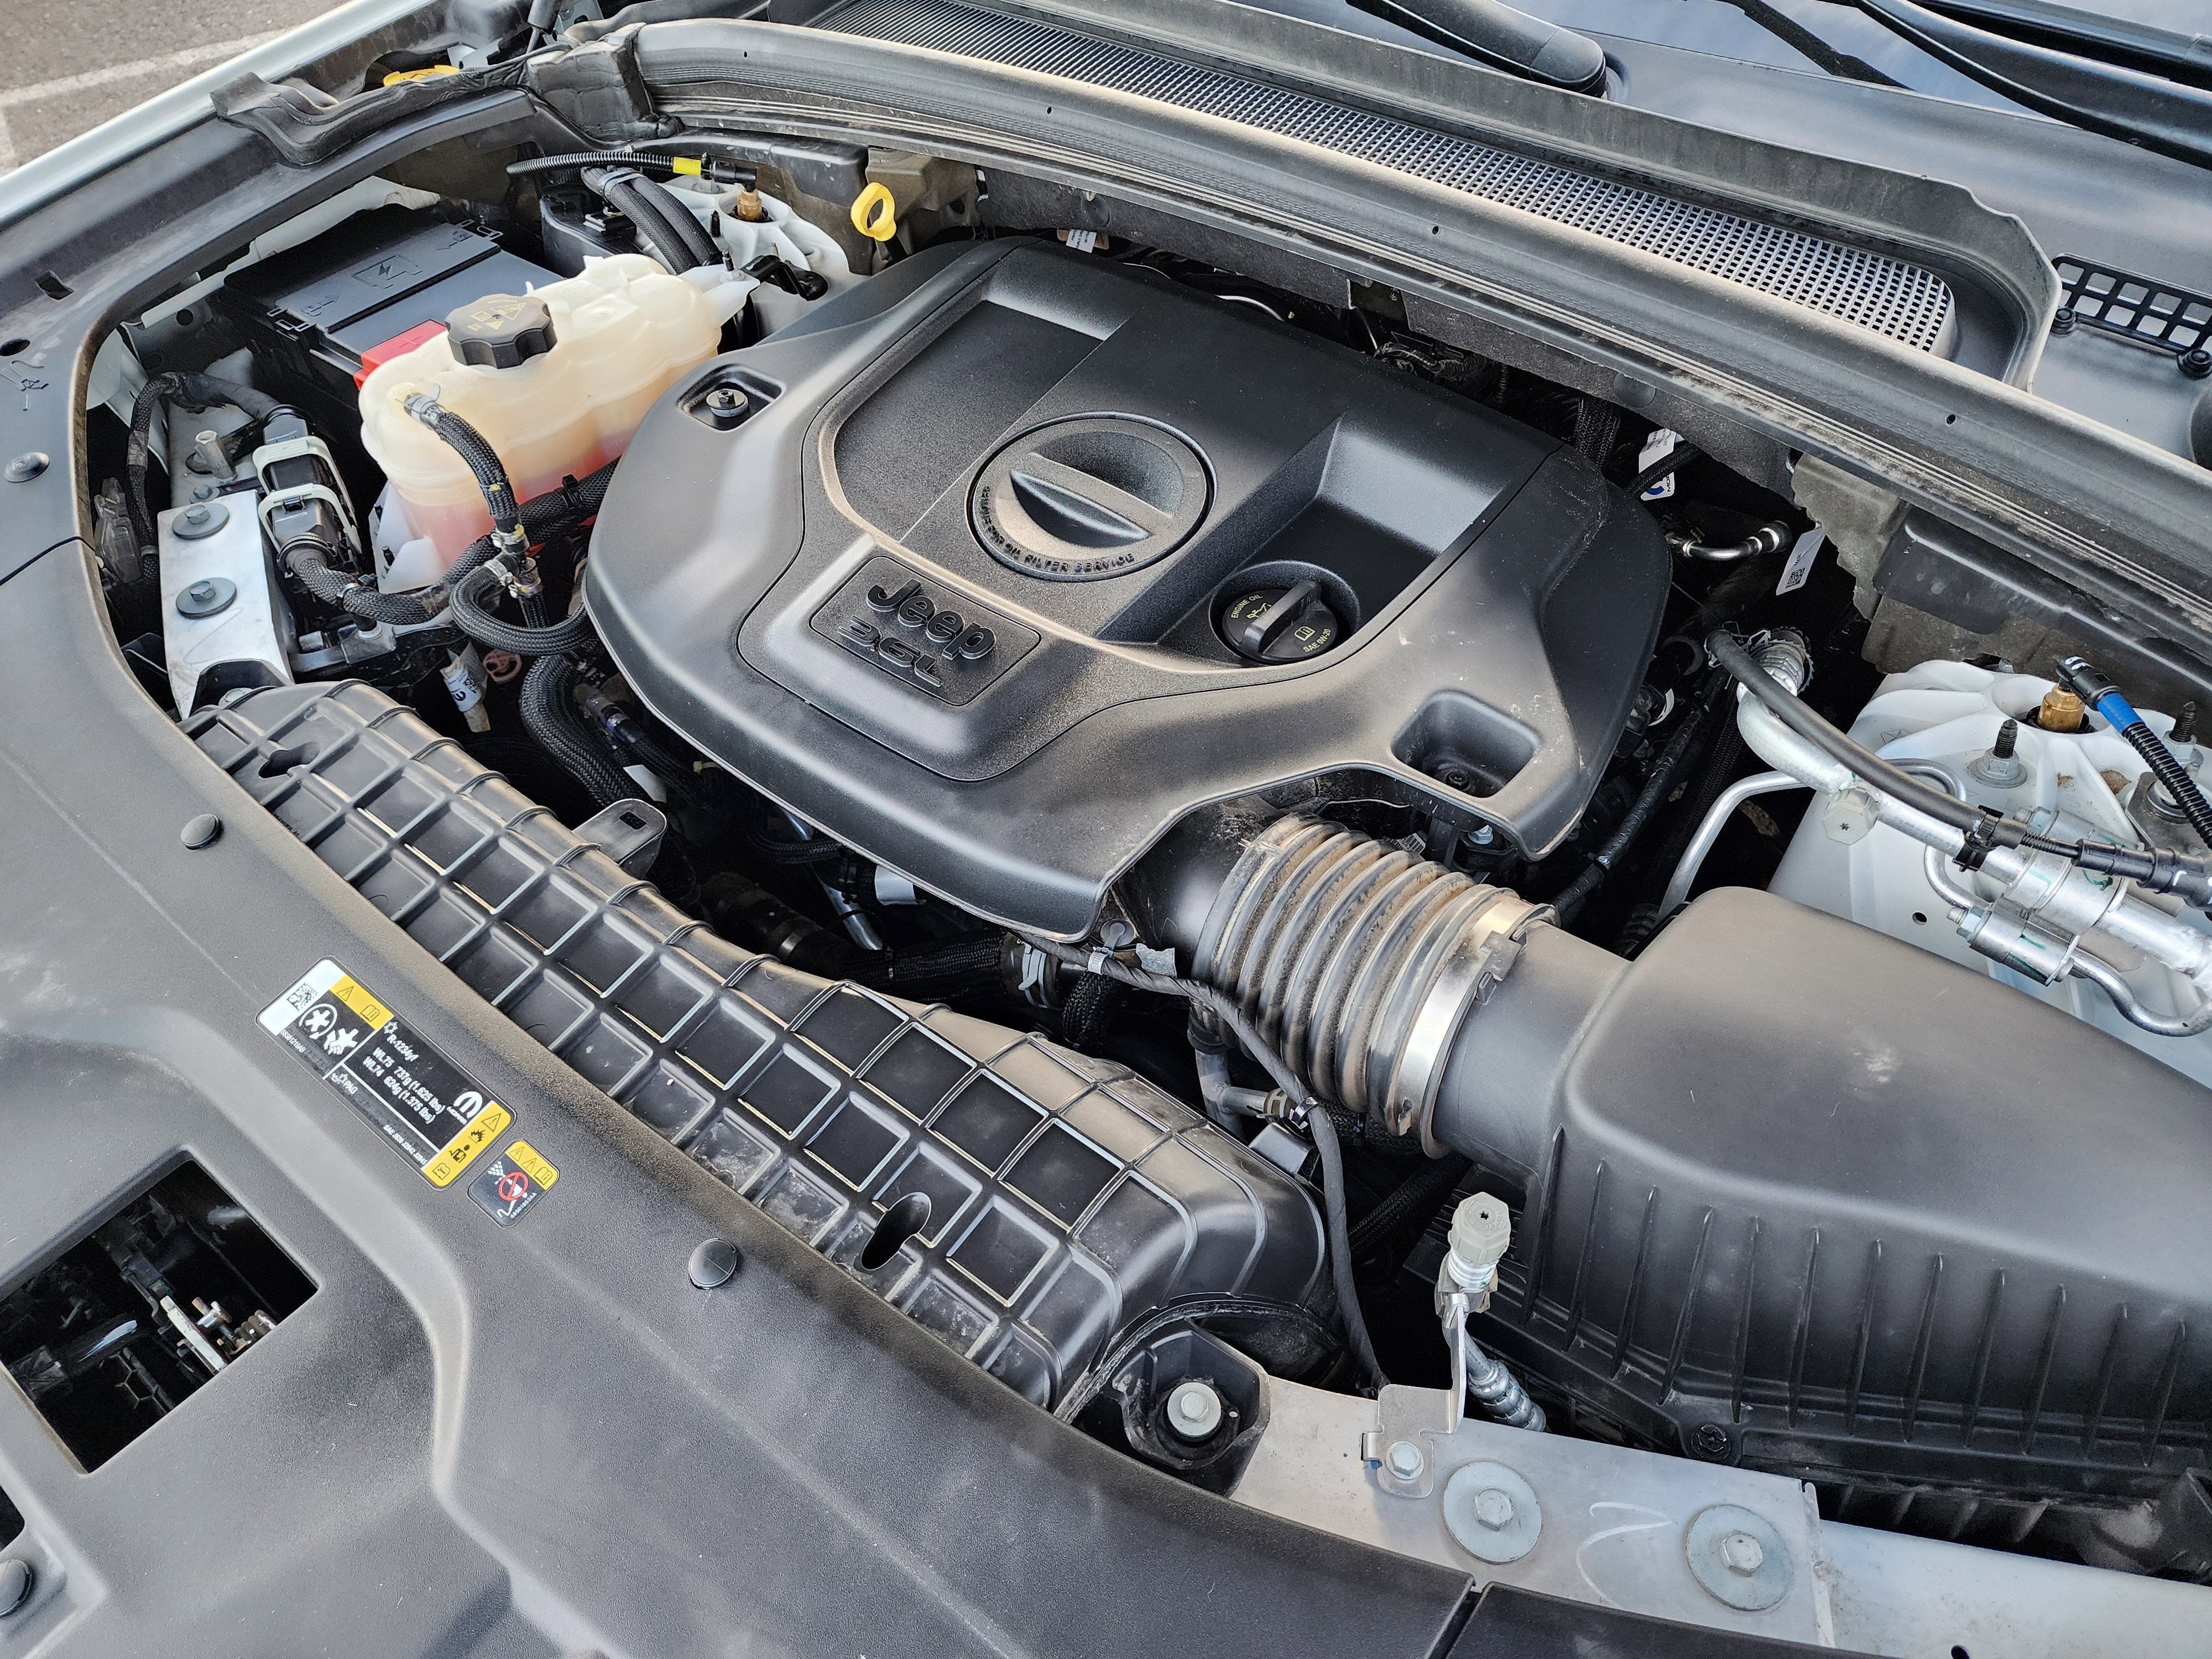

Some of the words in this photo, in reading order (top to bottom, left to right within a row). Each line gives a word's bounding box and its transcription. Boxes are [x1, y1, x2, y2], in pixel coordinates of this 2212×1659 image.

[1074, 553, 1134, 572] SERVICE
[866, 578, 997, 660] Jeep
[1230, 599, 1250, 618] ENGINE
[837, 615, 942, 687] 3.6L
[1303, 641, 1321, 653] SAE
[1317, 628, 1332, 645] 0W-20
[387, 1034, 419, 1062] R-1234yf
[343, 1080, 358, 1094] PAG
[363, 1056, 385, 1077] WL74
[383, 1076, 402, 1095] 624g
[398, 1090, 424, 1112] (1.375
[419, 1107, 436, 1125] lbs)
[372, 1047, 395, 1067] WL75
[394, 1066, 413, 1086] 737g
[408, 1081, 433, 1102] (1.625
[429, 1097, 446, 1115] lbs)
